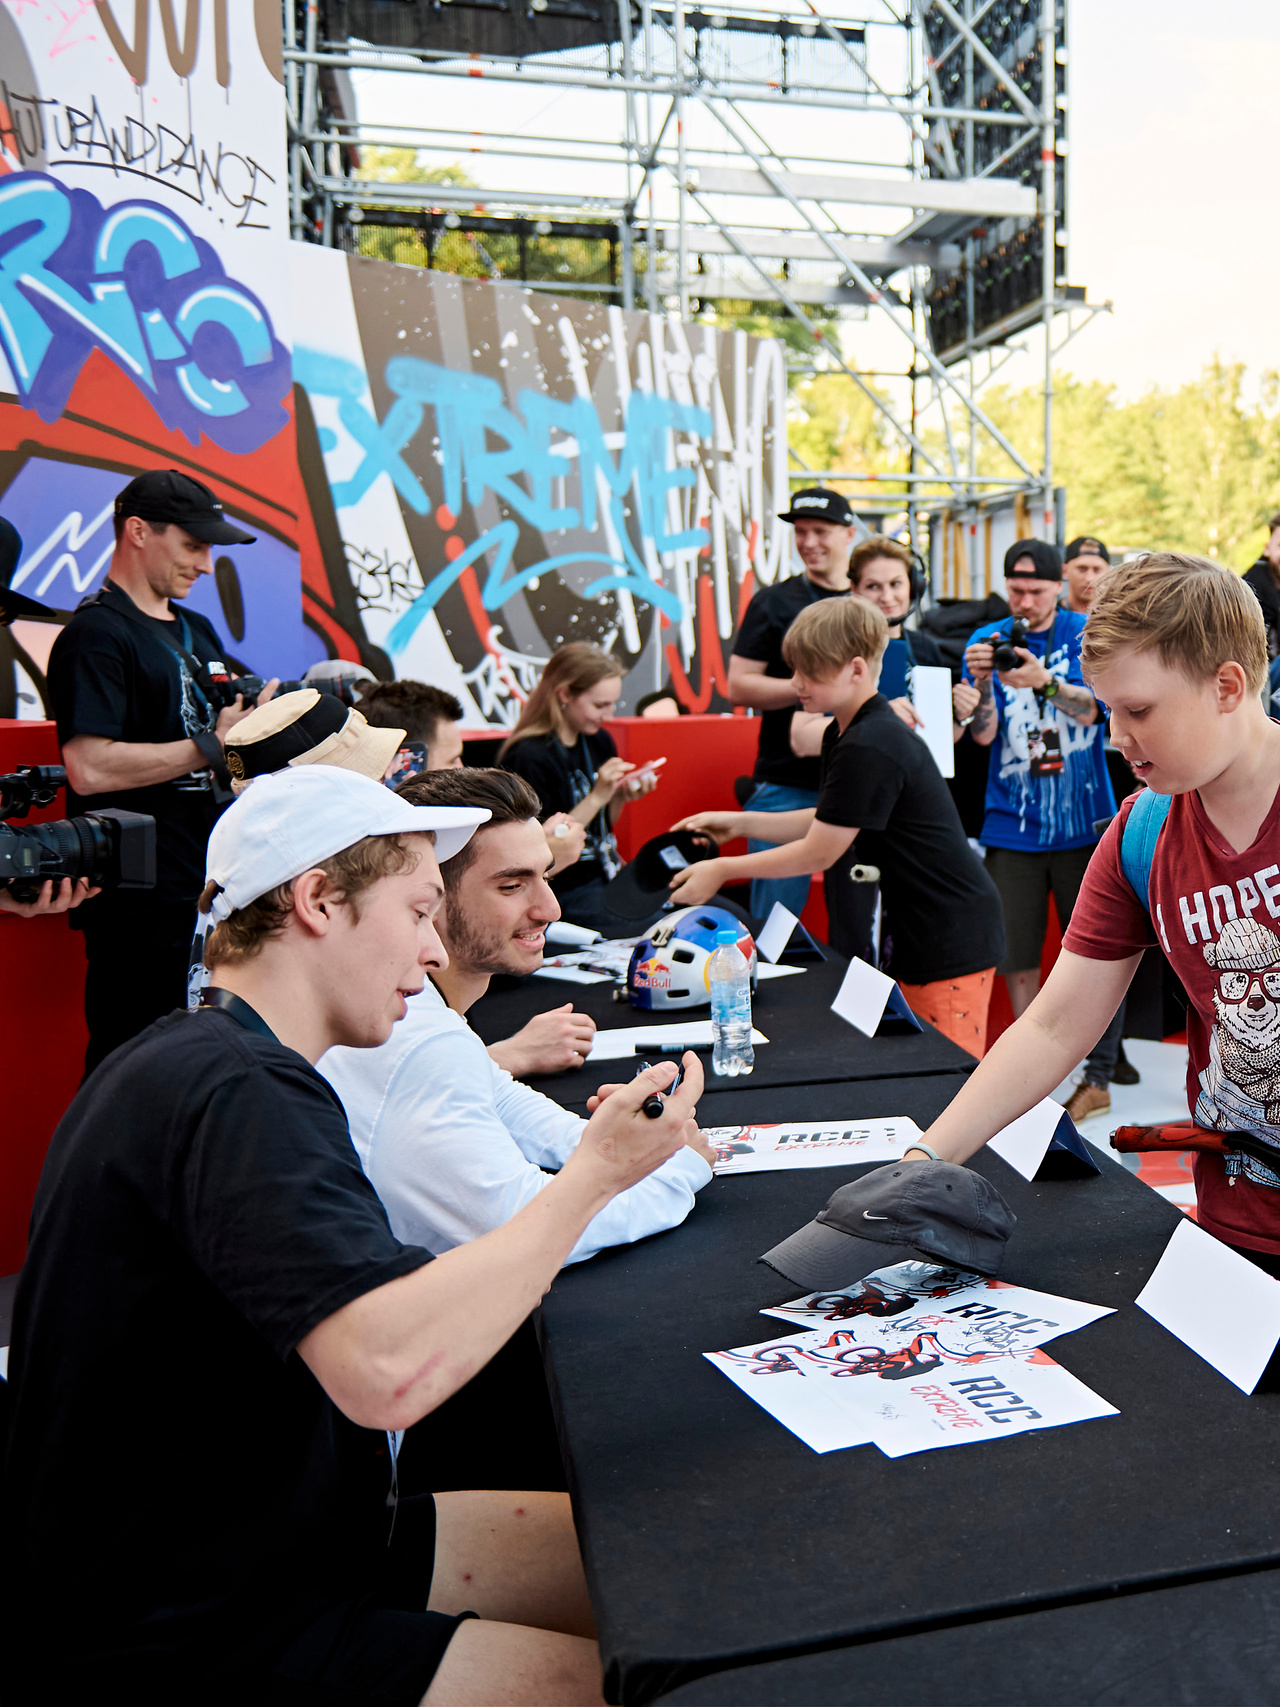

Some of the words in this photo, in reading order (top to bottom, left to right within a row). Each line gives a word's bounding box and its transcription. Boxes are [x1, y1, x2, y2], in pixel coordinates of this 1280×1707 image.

[293, 345, 714, 553] EXTREME
[633, 975, 650, 987] Red
[651, 976, 671, 988] Bull
[774, 1140, 868, 1151] EXTREME
[778, 1130, 870, 1144] RCC
[942, 1302, 1060, 1334] RCC
[910, 1384, 983, 1428] EXTREME
[948, 1375, 1043, 1424] RCC
